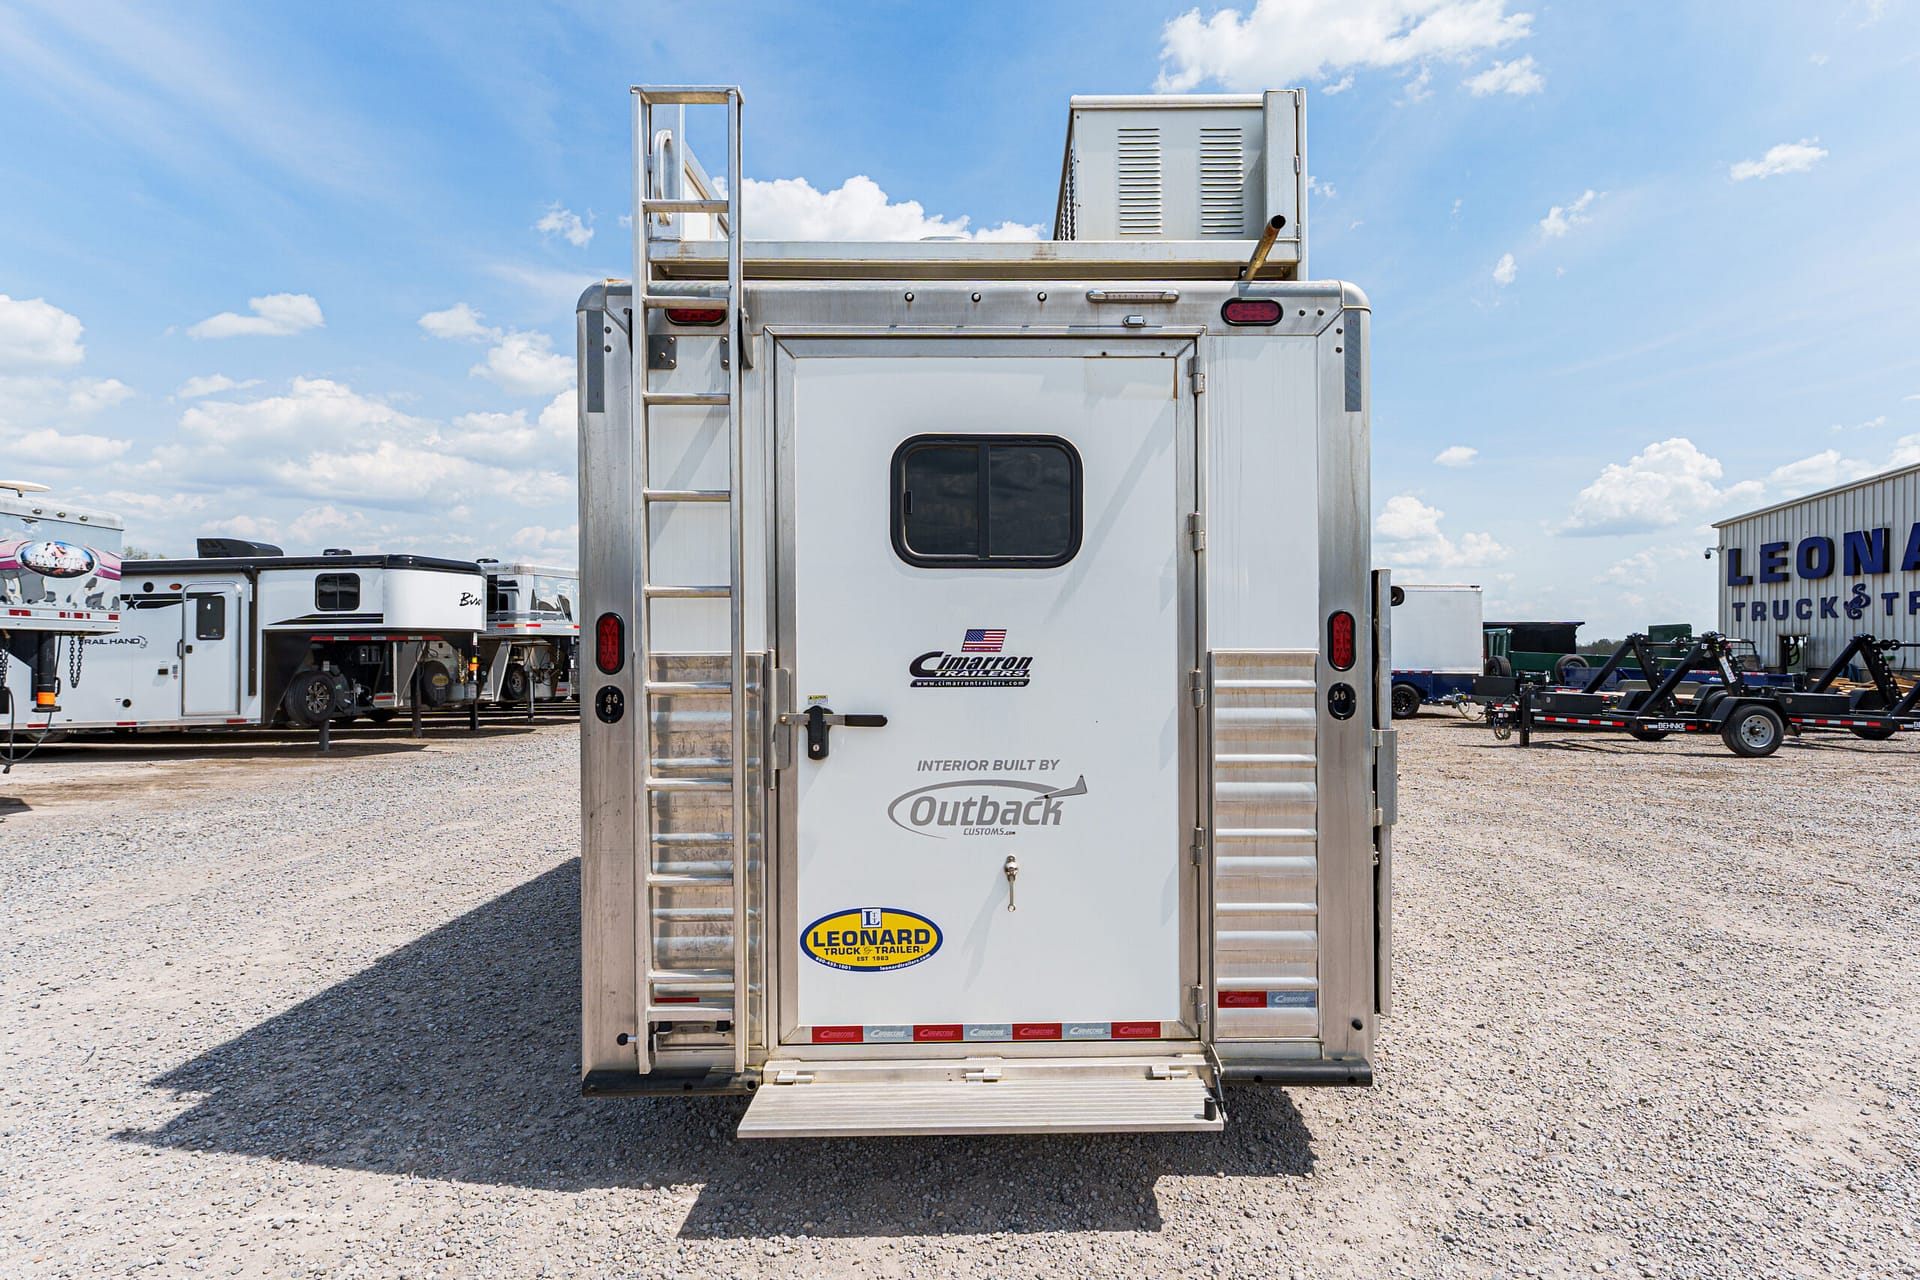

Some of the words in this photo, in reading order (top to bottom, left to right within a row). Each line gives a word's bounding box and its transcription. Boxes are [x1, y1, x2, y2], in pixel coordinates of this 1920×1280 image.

[1732, 596, 1839, 622] TRUCK
[909, 651, 1033, 677] Cimarron
[917, 759, 989, 772] INTERIOR
[992, 759, 1037, 771] BUILT
[1038, 759, 1060, 771] BY
[910, 795, 1064, 827] Outback
[813, 928, 931, 947] LEONARD
[823, 947, 861, 955] TRUCK
[875, 946, 920, 954] TRAILER
